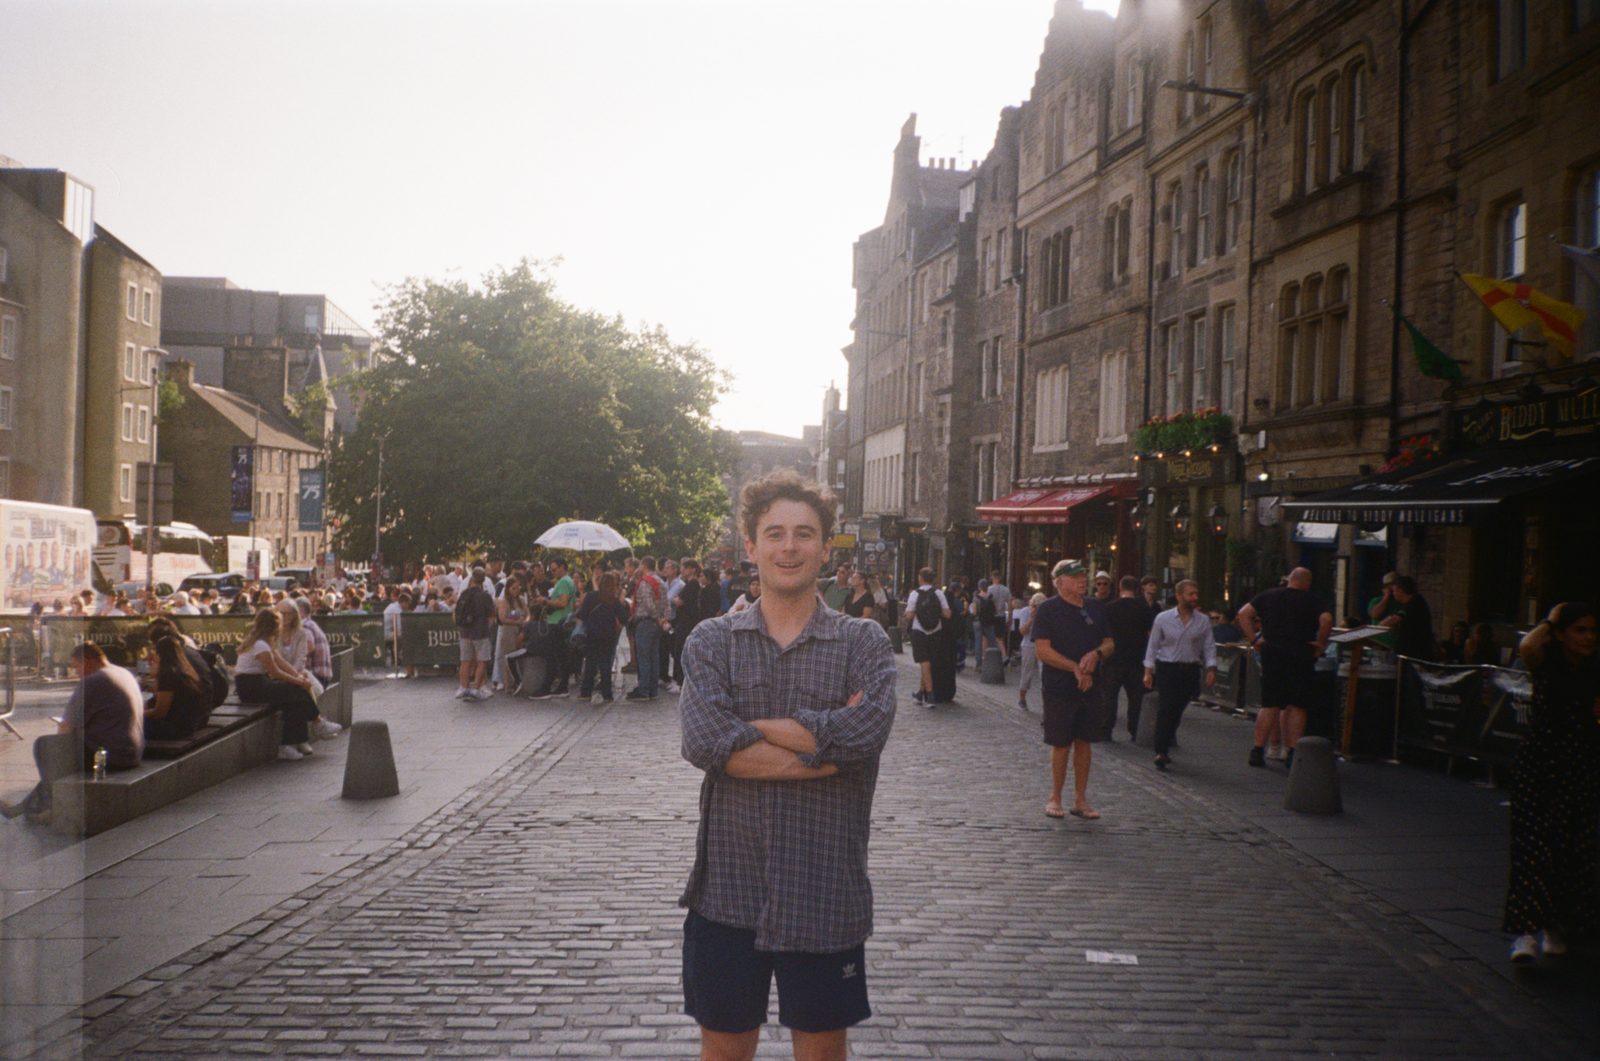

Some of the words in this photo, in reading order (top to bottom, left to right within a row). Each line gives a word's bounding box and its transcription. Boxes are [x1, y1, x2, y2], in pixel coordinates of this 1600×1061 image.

[1499, 400, 1548, 441] BIDDY
[302, 484, 320, 500] 75
[1363, 510, 1393, 522] BIDDY
[192, 631, 246, 648] BIDDY'S
[427, 630, 461, 647] BIDD
